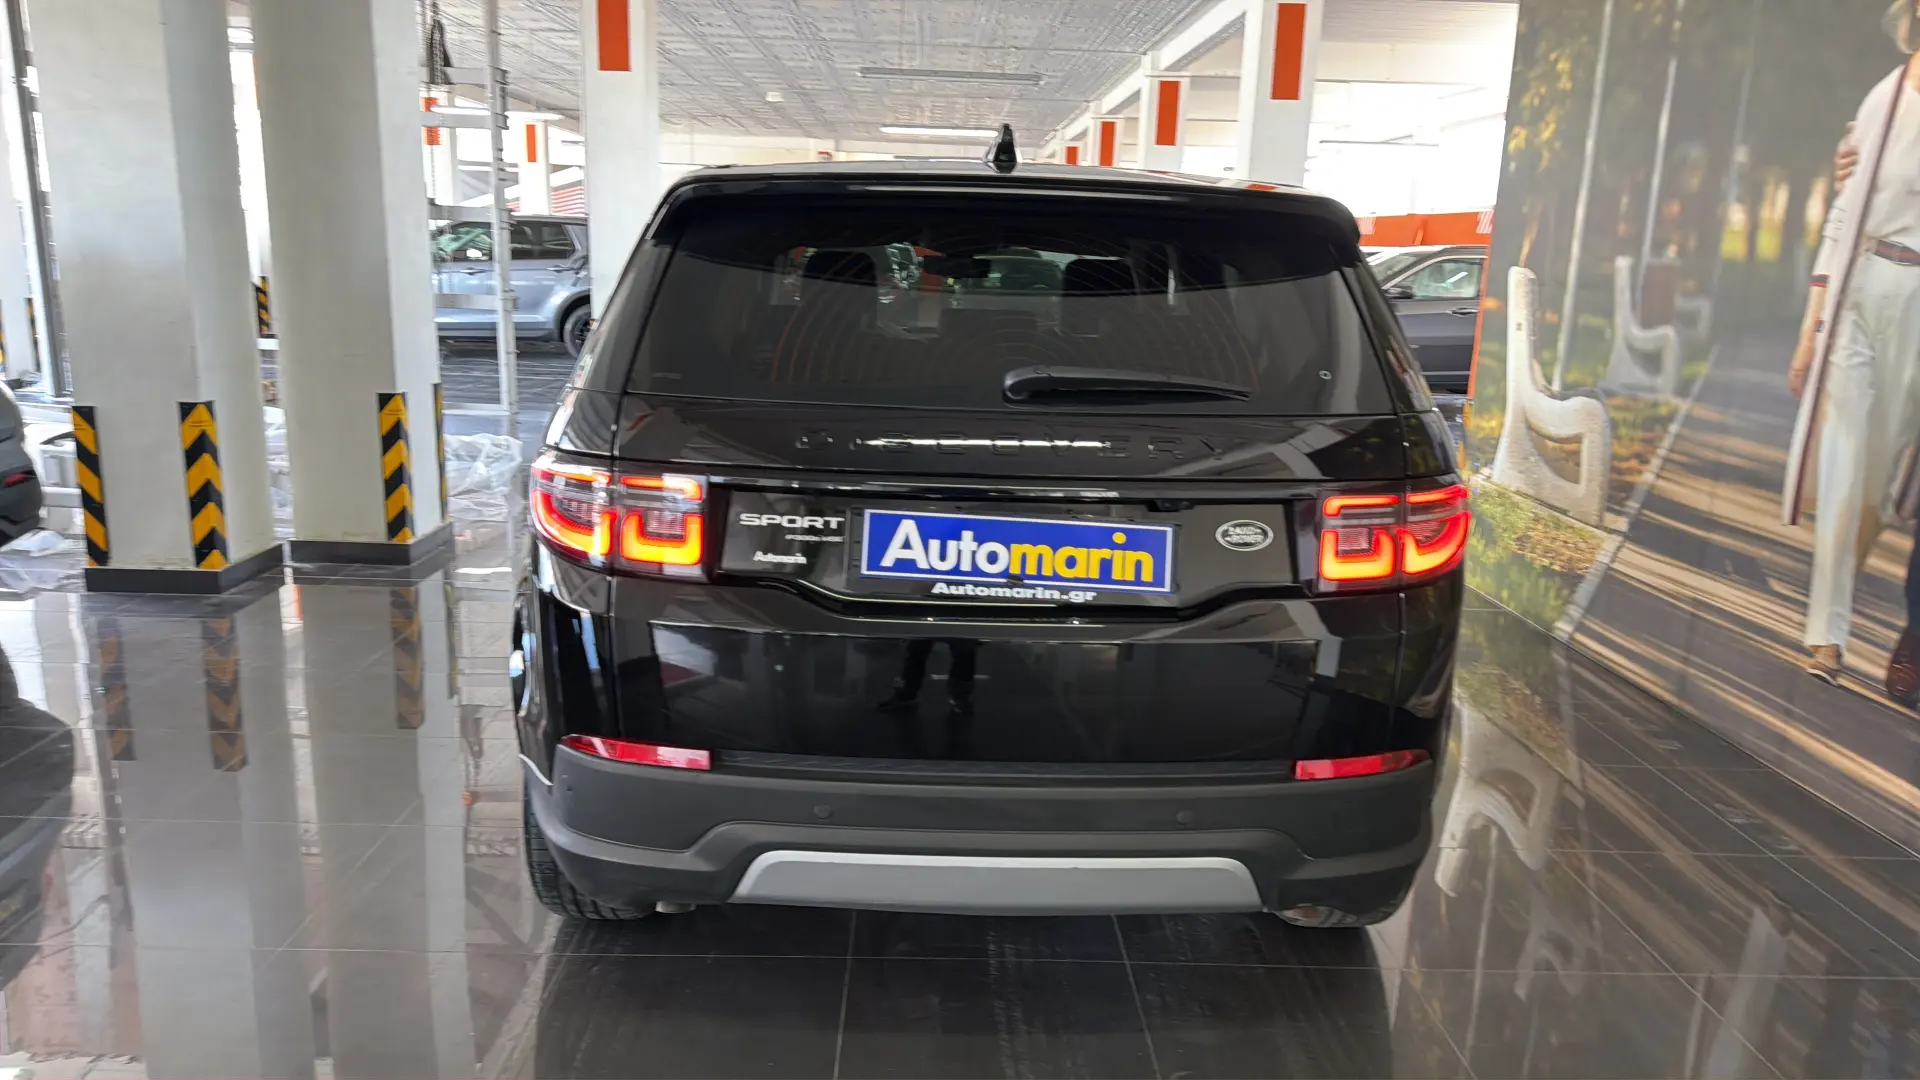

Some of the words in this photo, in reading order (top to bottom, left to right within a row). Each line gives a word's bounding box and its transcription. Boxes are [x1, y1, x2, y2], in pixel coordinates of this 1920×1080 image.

[739, 513, 845, 529] SPORT
[879, 519, 1154, 583] Automarin
[930, 582, 1098, 603] Automarin.gr
